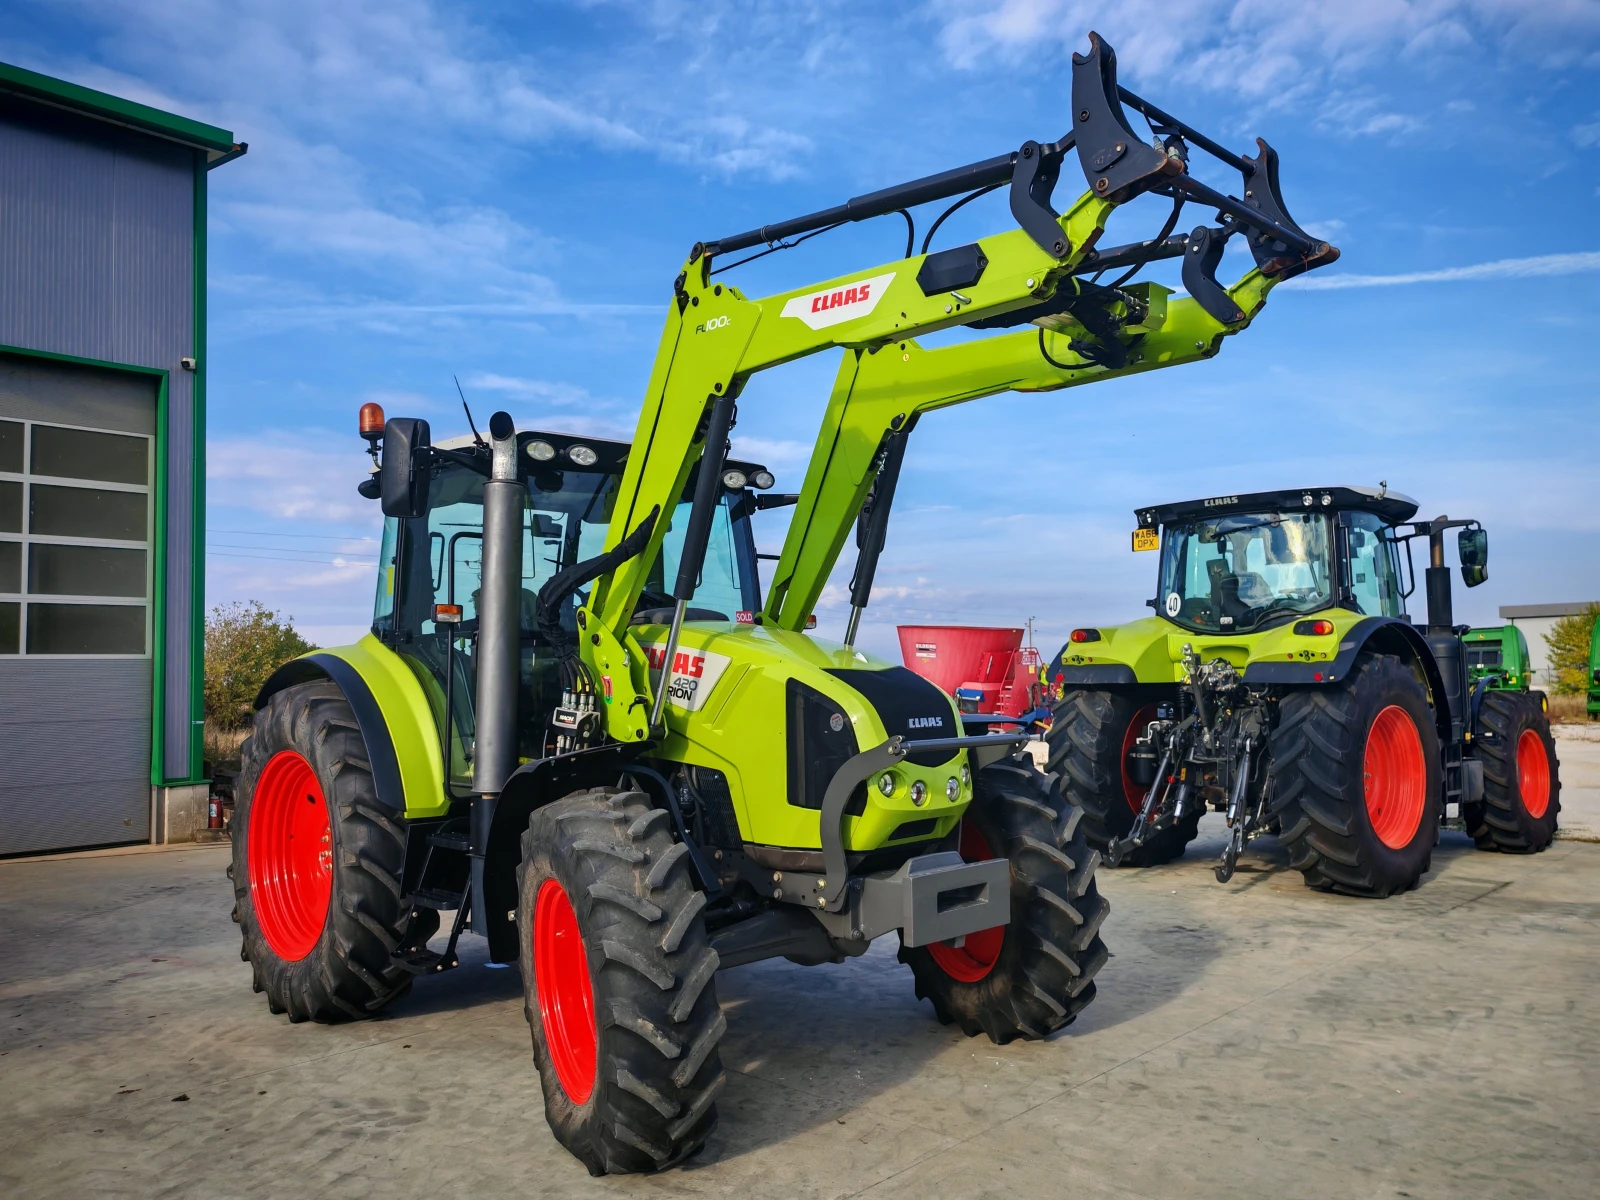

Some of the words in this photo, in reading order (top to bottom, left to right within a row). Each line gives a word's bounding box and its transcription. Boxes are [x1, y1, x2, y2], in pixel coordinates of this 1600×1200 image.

[811, 284, 870, 313] CLAAS
[1204, 496, 1239, 507] CLAAS
[1168, 596, 1178, 613] 40
[736, 612, 753, 622] SOLD
[673, 676, 698, 692] 420
[908, 717, 943, 729] CLAAS
